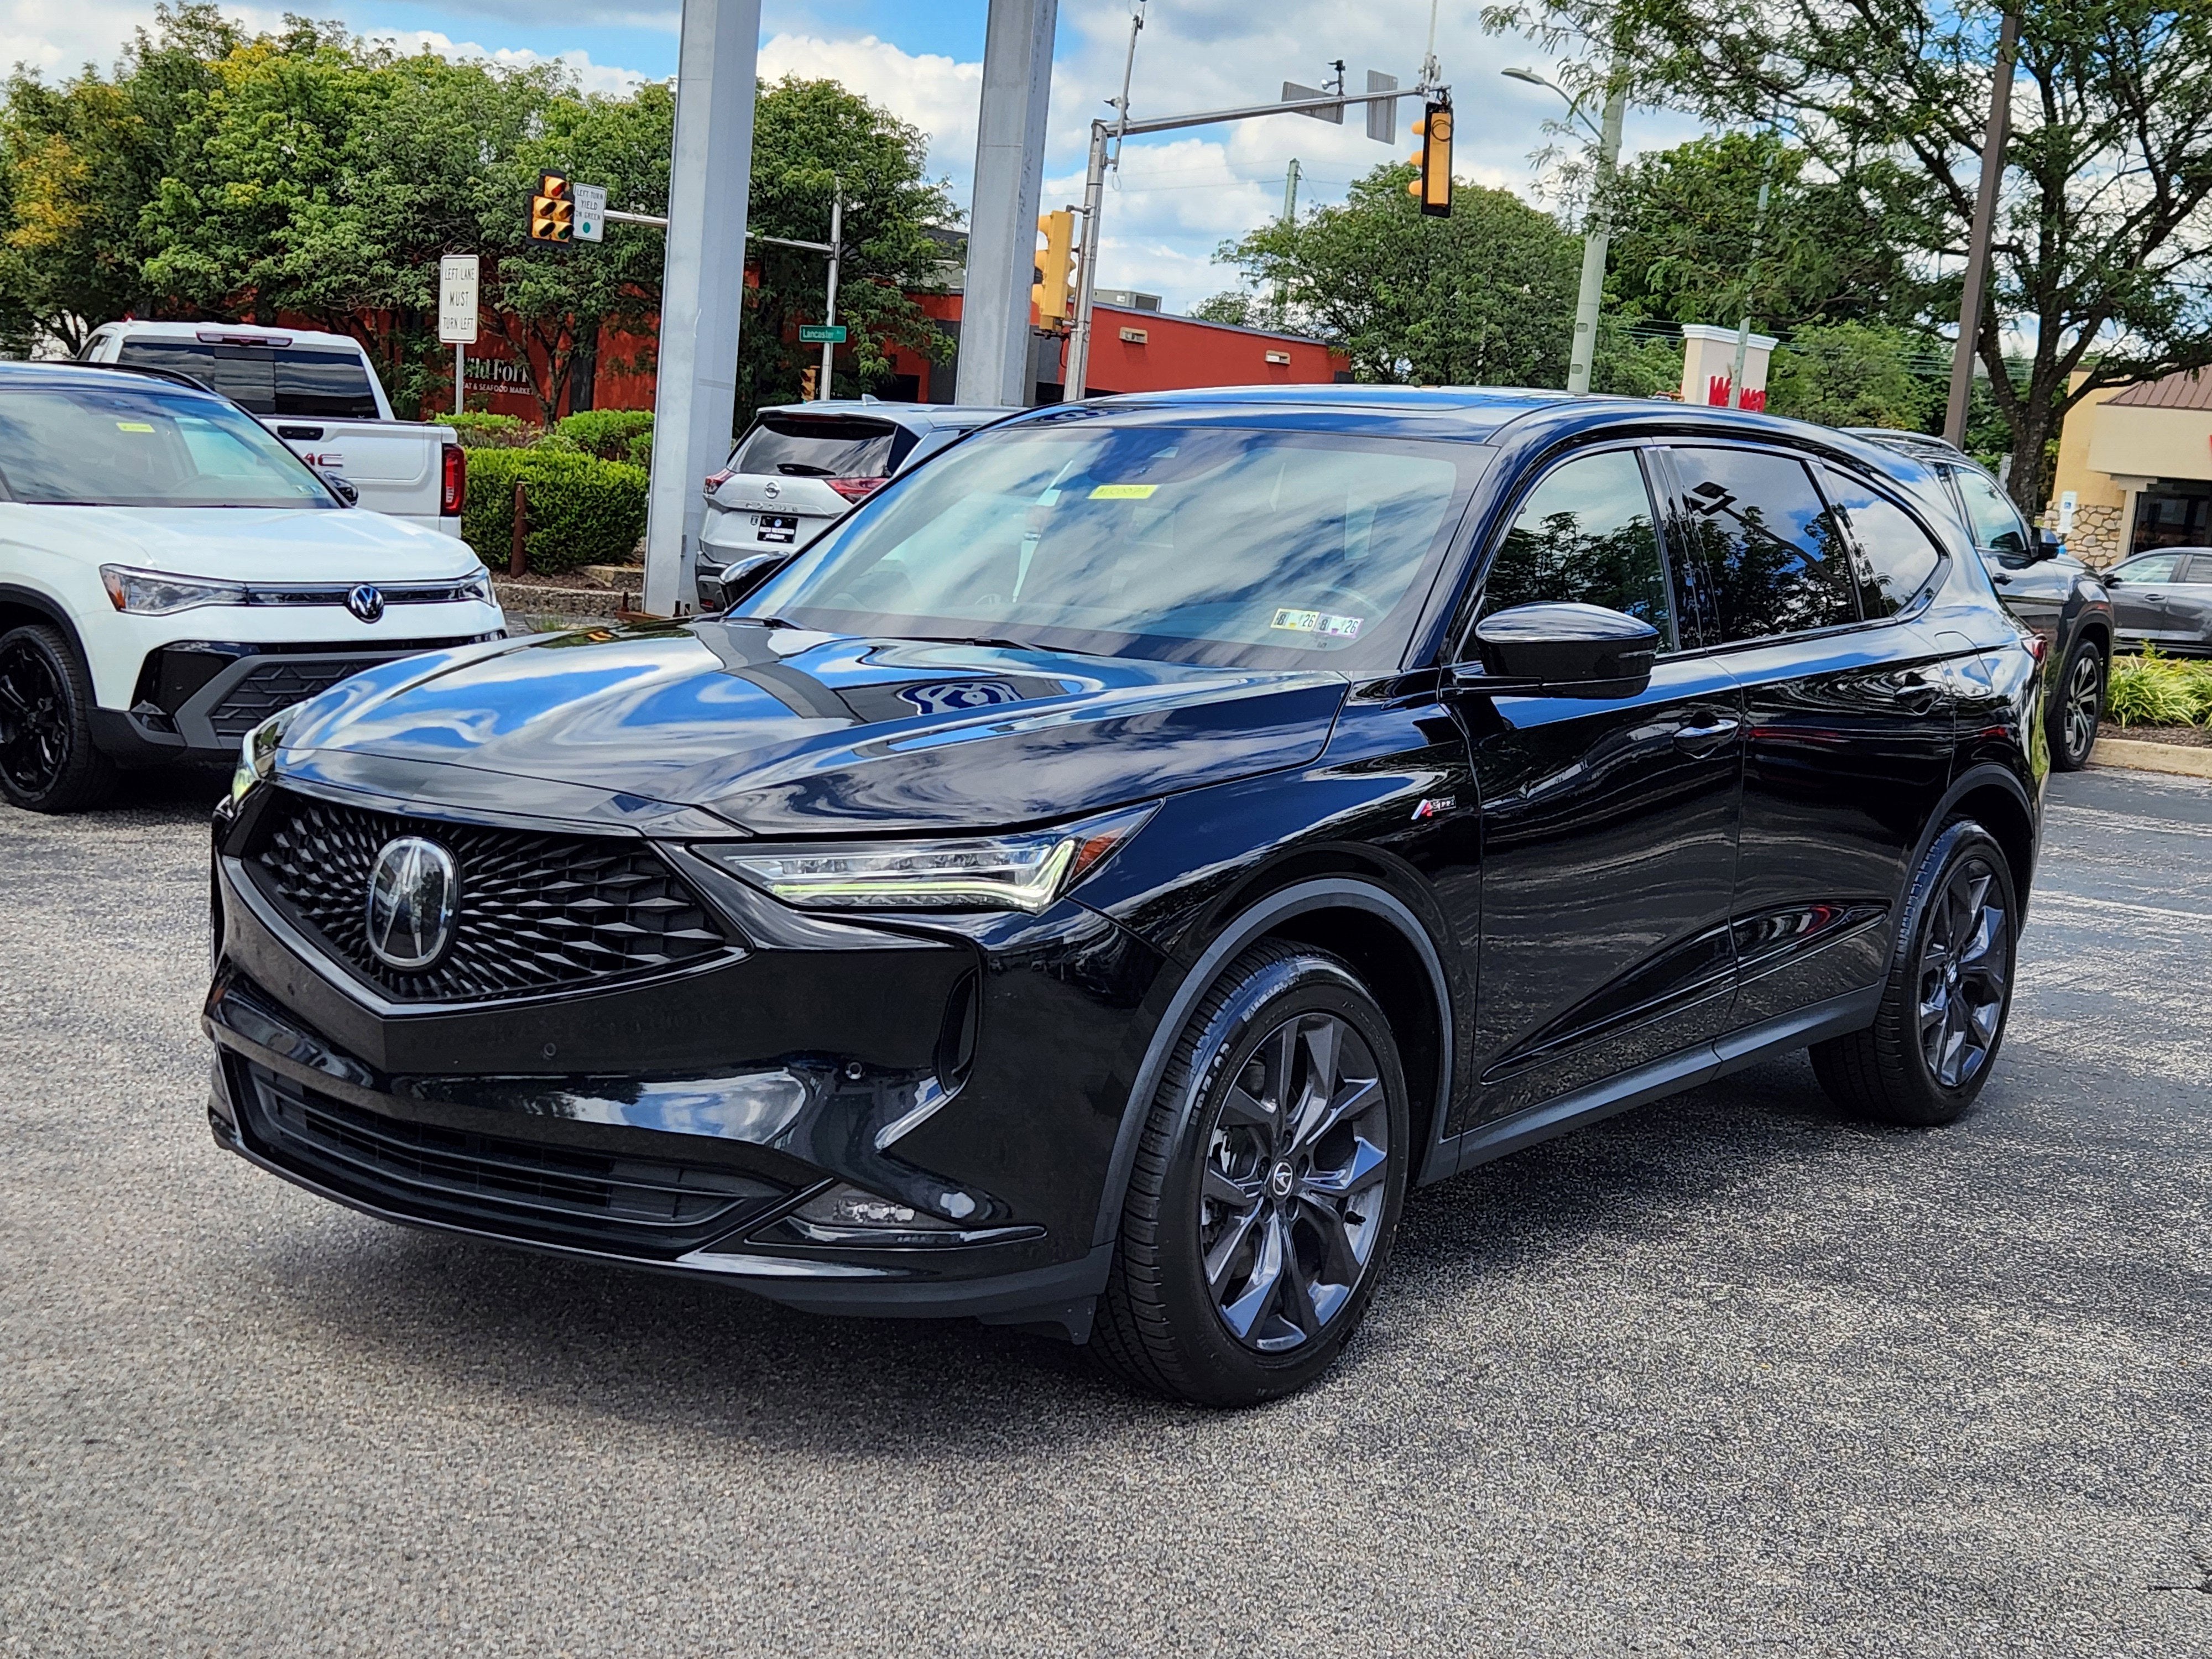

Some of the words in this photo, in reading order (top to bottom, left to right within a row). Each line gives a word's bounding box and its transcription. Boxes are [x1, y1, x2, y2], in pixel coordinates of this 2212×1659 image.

[577, 189, 589, 197] LEFT
[591, 191, 603, 200] TURN
[581, 200, 597, 210] YIELD
[584, 212, 601, 221] GREEN
[445, 268, 458, 280] LEFT
[461, 268, 474, 280] LANE
[449, 291, 469, 306] MUST
[443, 316, 458, 330] TURN
[461, 317, 473, 330] LEFT
[802, 328, 834, 338] Lancaster
[479, 383, 508, 393] SEAFOOD
[1709, 375, 1766, 413] Wwa
